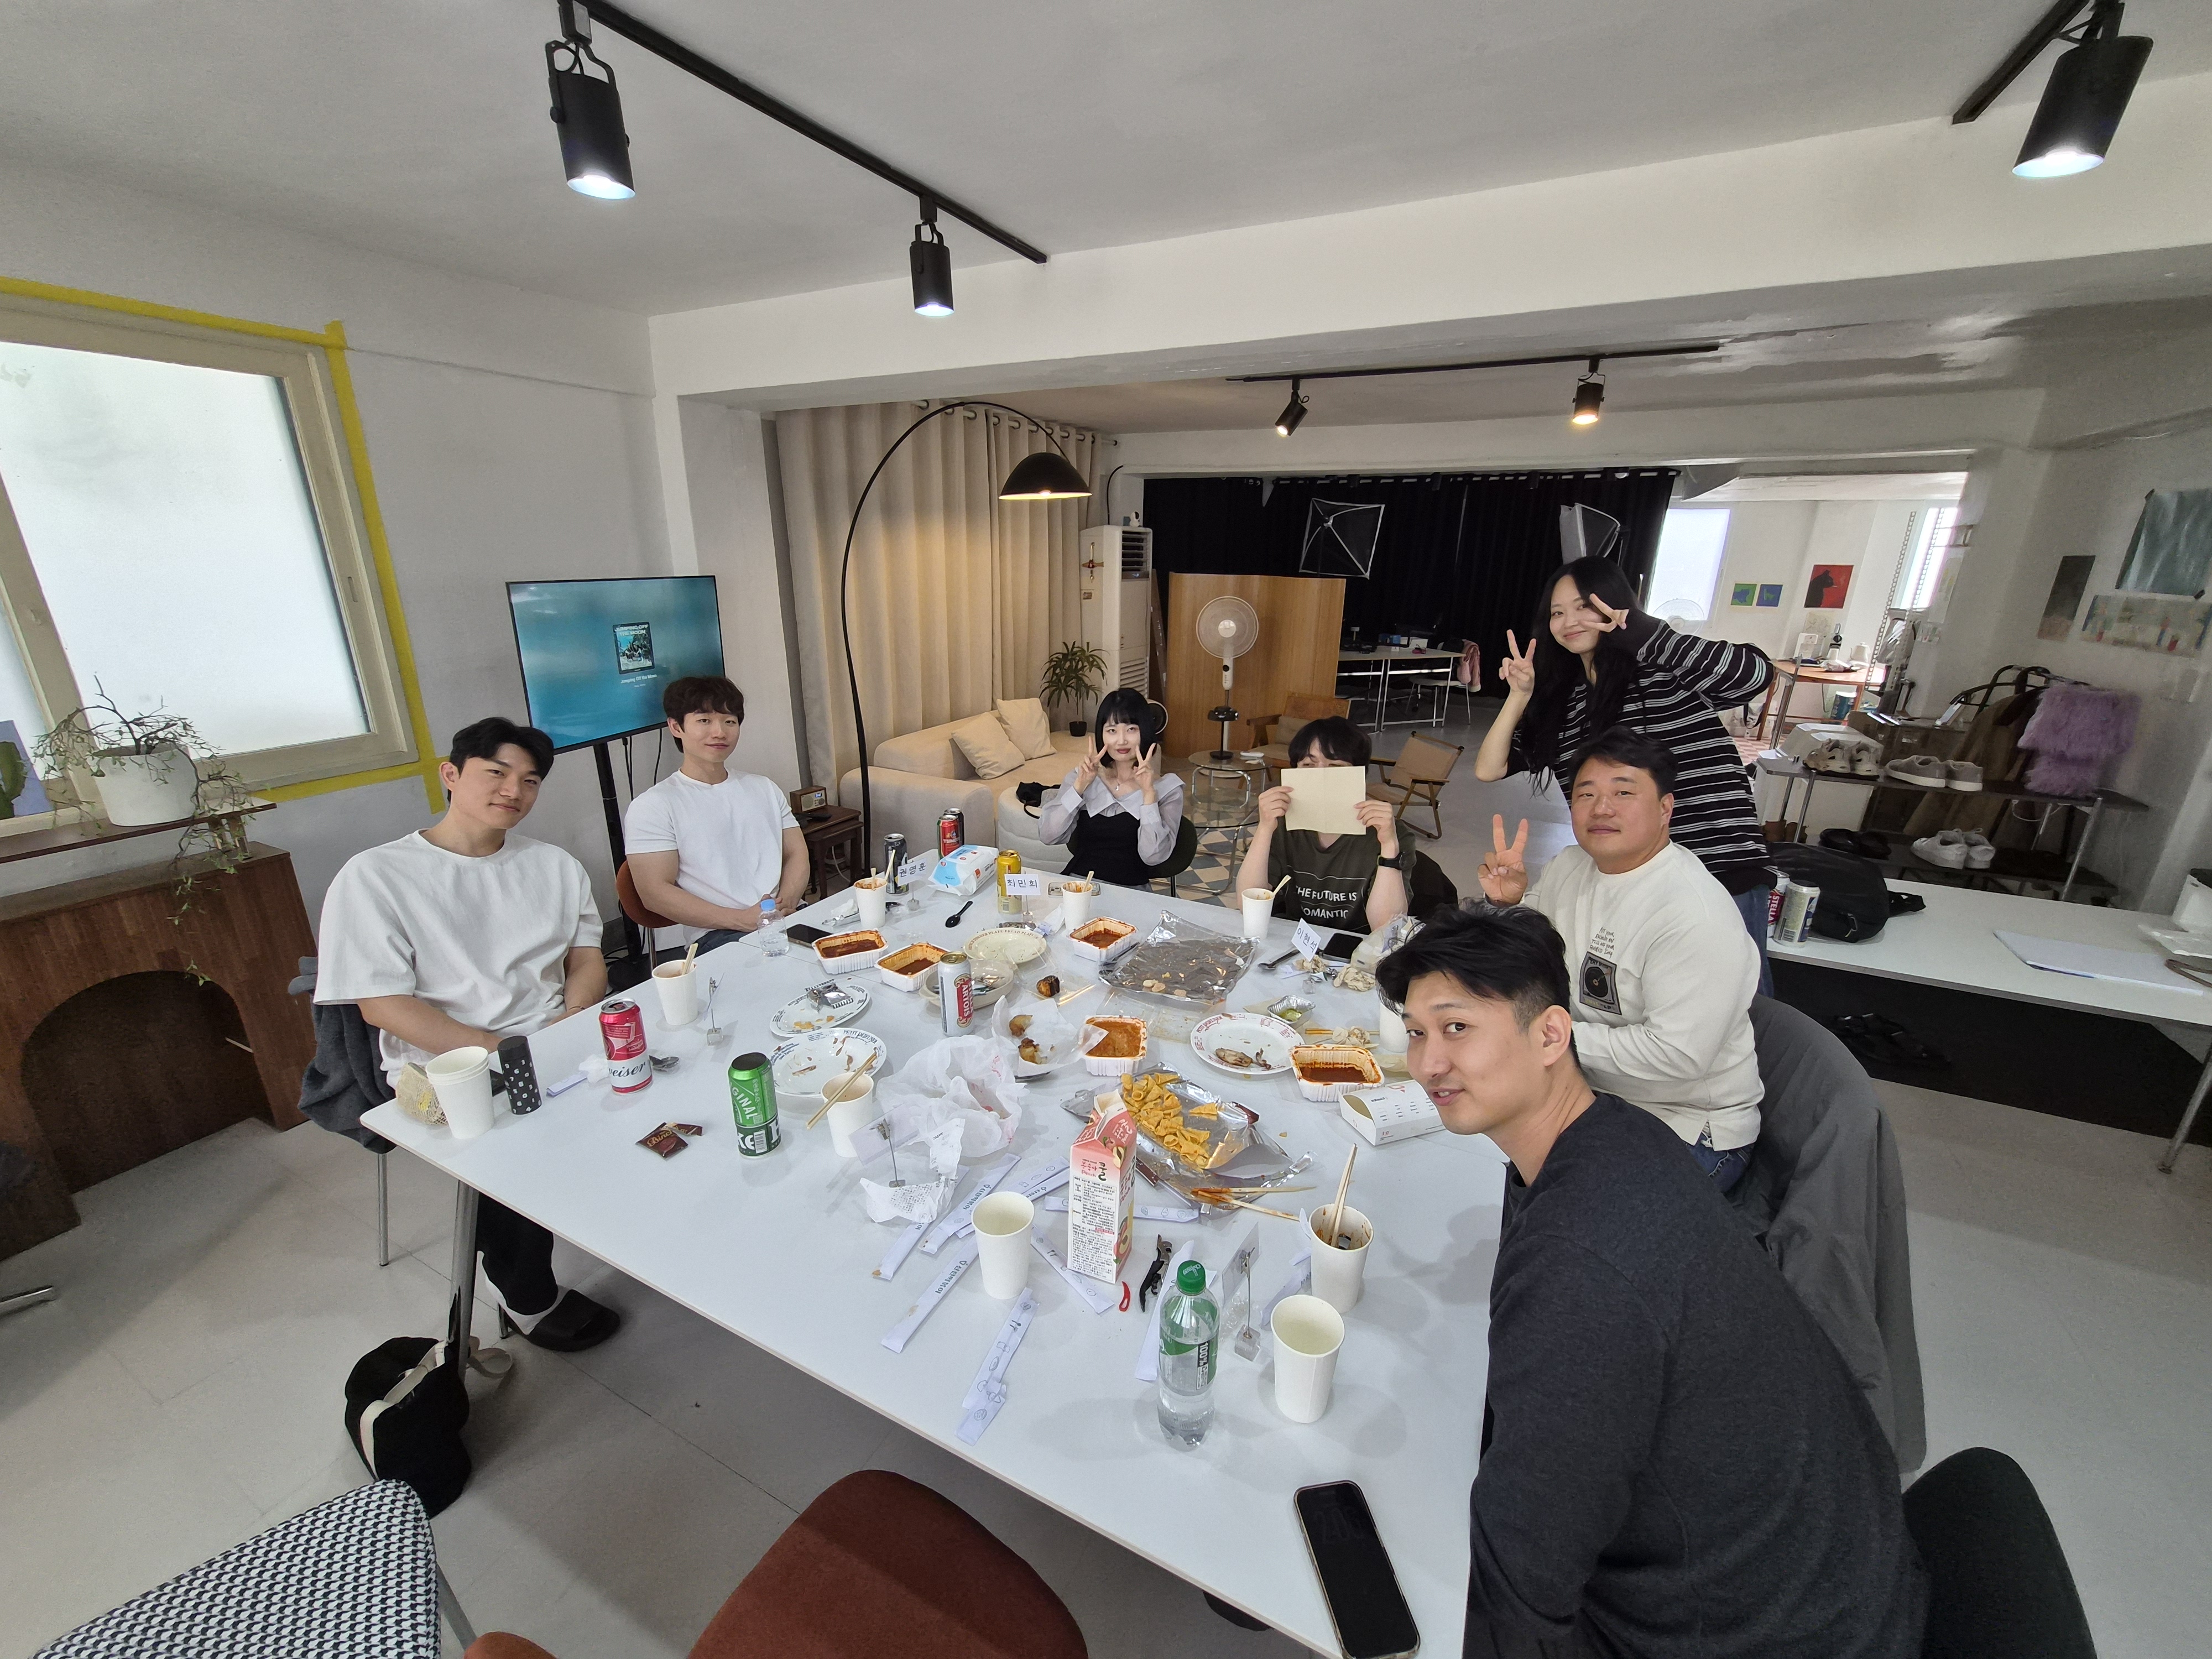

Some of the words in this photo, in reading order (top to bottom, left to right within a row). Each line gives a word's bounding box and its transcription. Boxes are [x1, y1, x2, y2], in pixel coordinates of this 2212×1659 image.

[899, 862, 926, 877] 권영훈
[1006, 879, 1037, 888] 최민희
[1296, 886, 1311, 898] HE
[1312, 890, 1346, 901] FUTURE
[1349, 892, 1357, 901] IS
[1301, 906, 1349, 919] OMANTIC
[1768, 895, 1780, 921] STELLA
[1297, 928, 1317, 953] 이현석
[962, 985, 970, 1017] ARTOIS
[732, 1082, 758, 1119] GINAL
[1098, 1161, 1108, 1182] 쿨
[935, 1265, 962, 1294] 신전떡볶이
[1199, 1342, 1208, 1366] 100%
